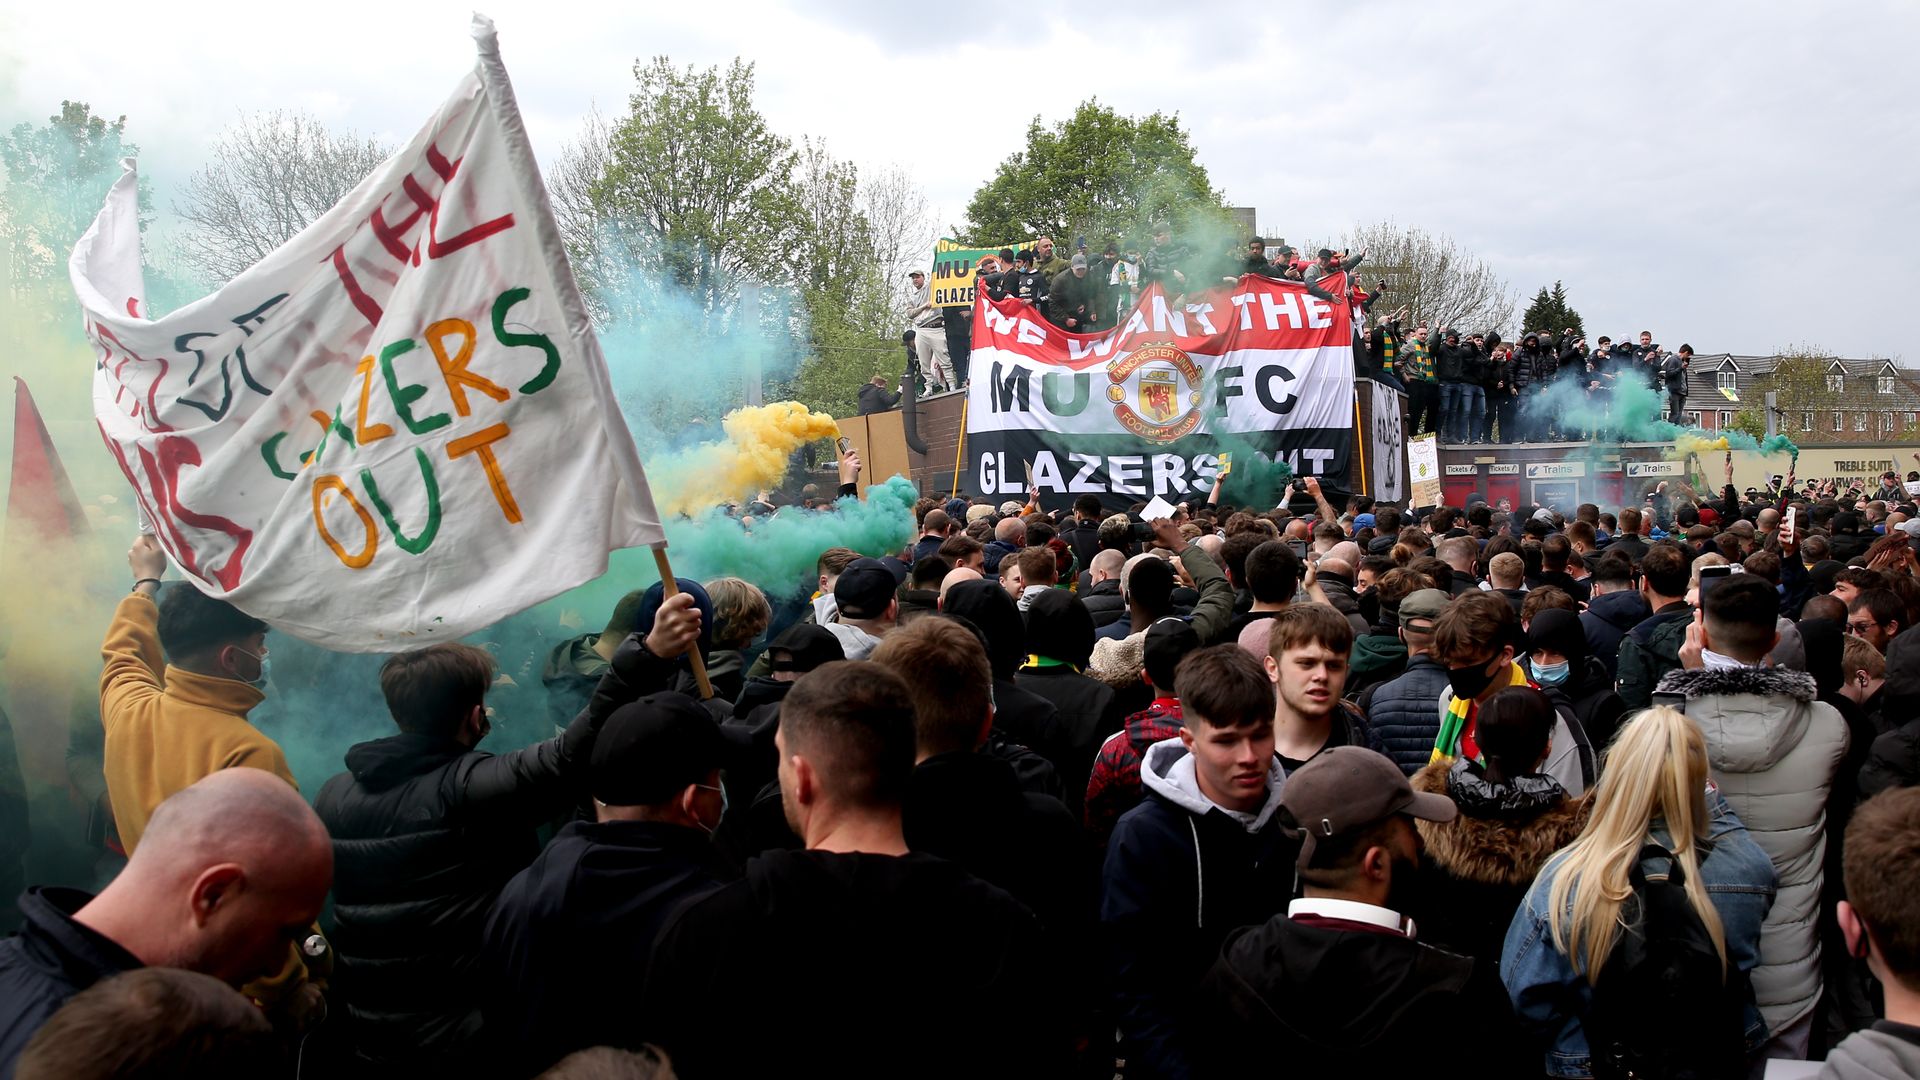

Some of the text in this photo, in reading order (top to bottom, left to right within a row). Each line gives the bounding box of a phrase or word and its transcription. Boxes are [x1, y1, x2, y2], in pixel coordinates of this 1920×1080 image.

[936, 260, 970, 280] MU
[983, 292, 1334, 361] WE WANT THE
[1113, 347, 1175, 380] MANCHESTER
[1122, 412, 1196, 437] FOOTBALL CLUB
[979, 450, 1220, 496] GLAZERS
[1543, 465, 1573, 474] Trains
[1643, 464, 1672, 473] Trains
[1834, 460, 1893, 472] TREBLE SUITE
[311, 422, 524, 570] OUT
